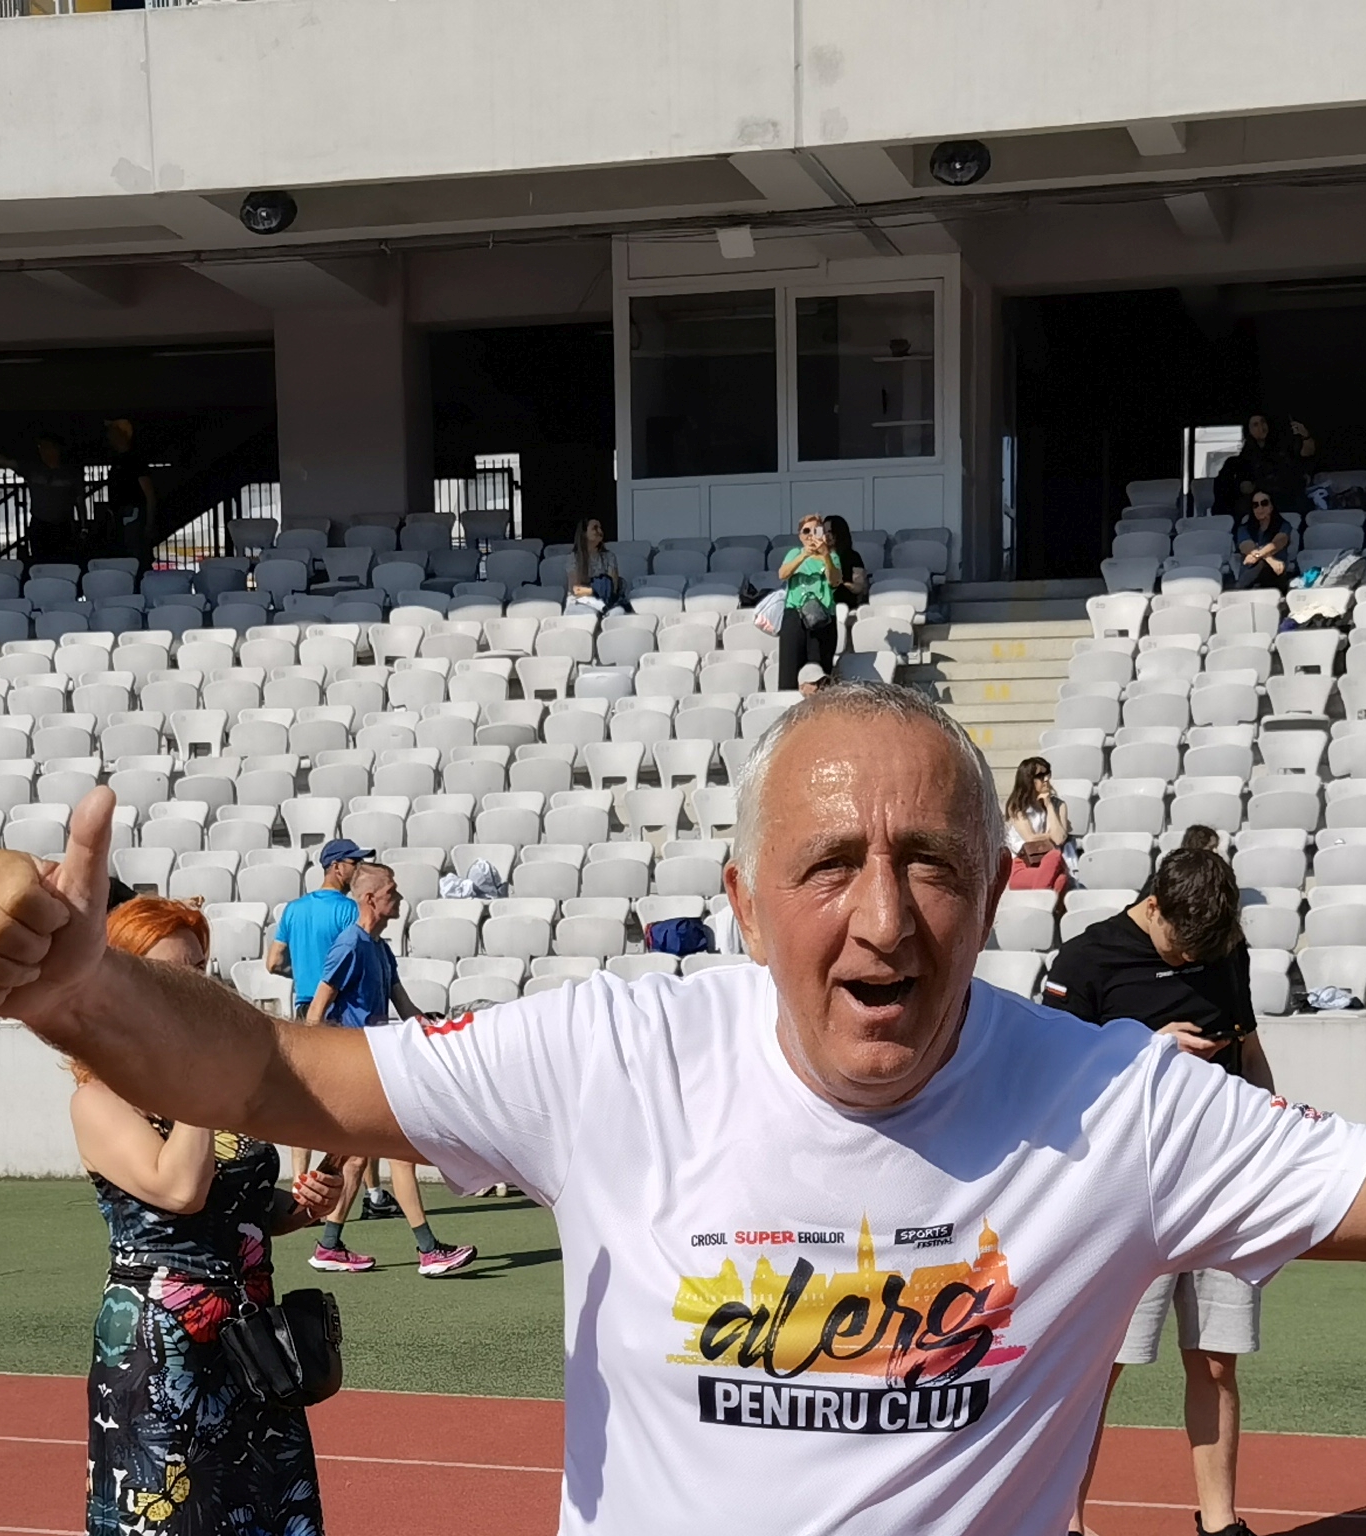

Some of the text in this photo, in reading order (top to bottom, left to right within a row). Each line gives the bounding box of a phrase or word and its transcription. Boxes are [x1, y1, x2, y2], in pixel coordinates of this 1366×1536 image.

[691, 1230, 845, 1247] CROSUL SUPER EROILOR
[899, 1226, 948, 1240] SPORTS
[699, 1257, 995, 1388] alerg
[715, 1382, 972, 1431] PENTRU CLUJ
